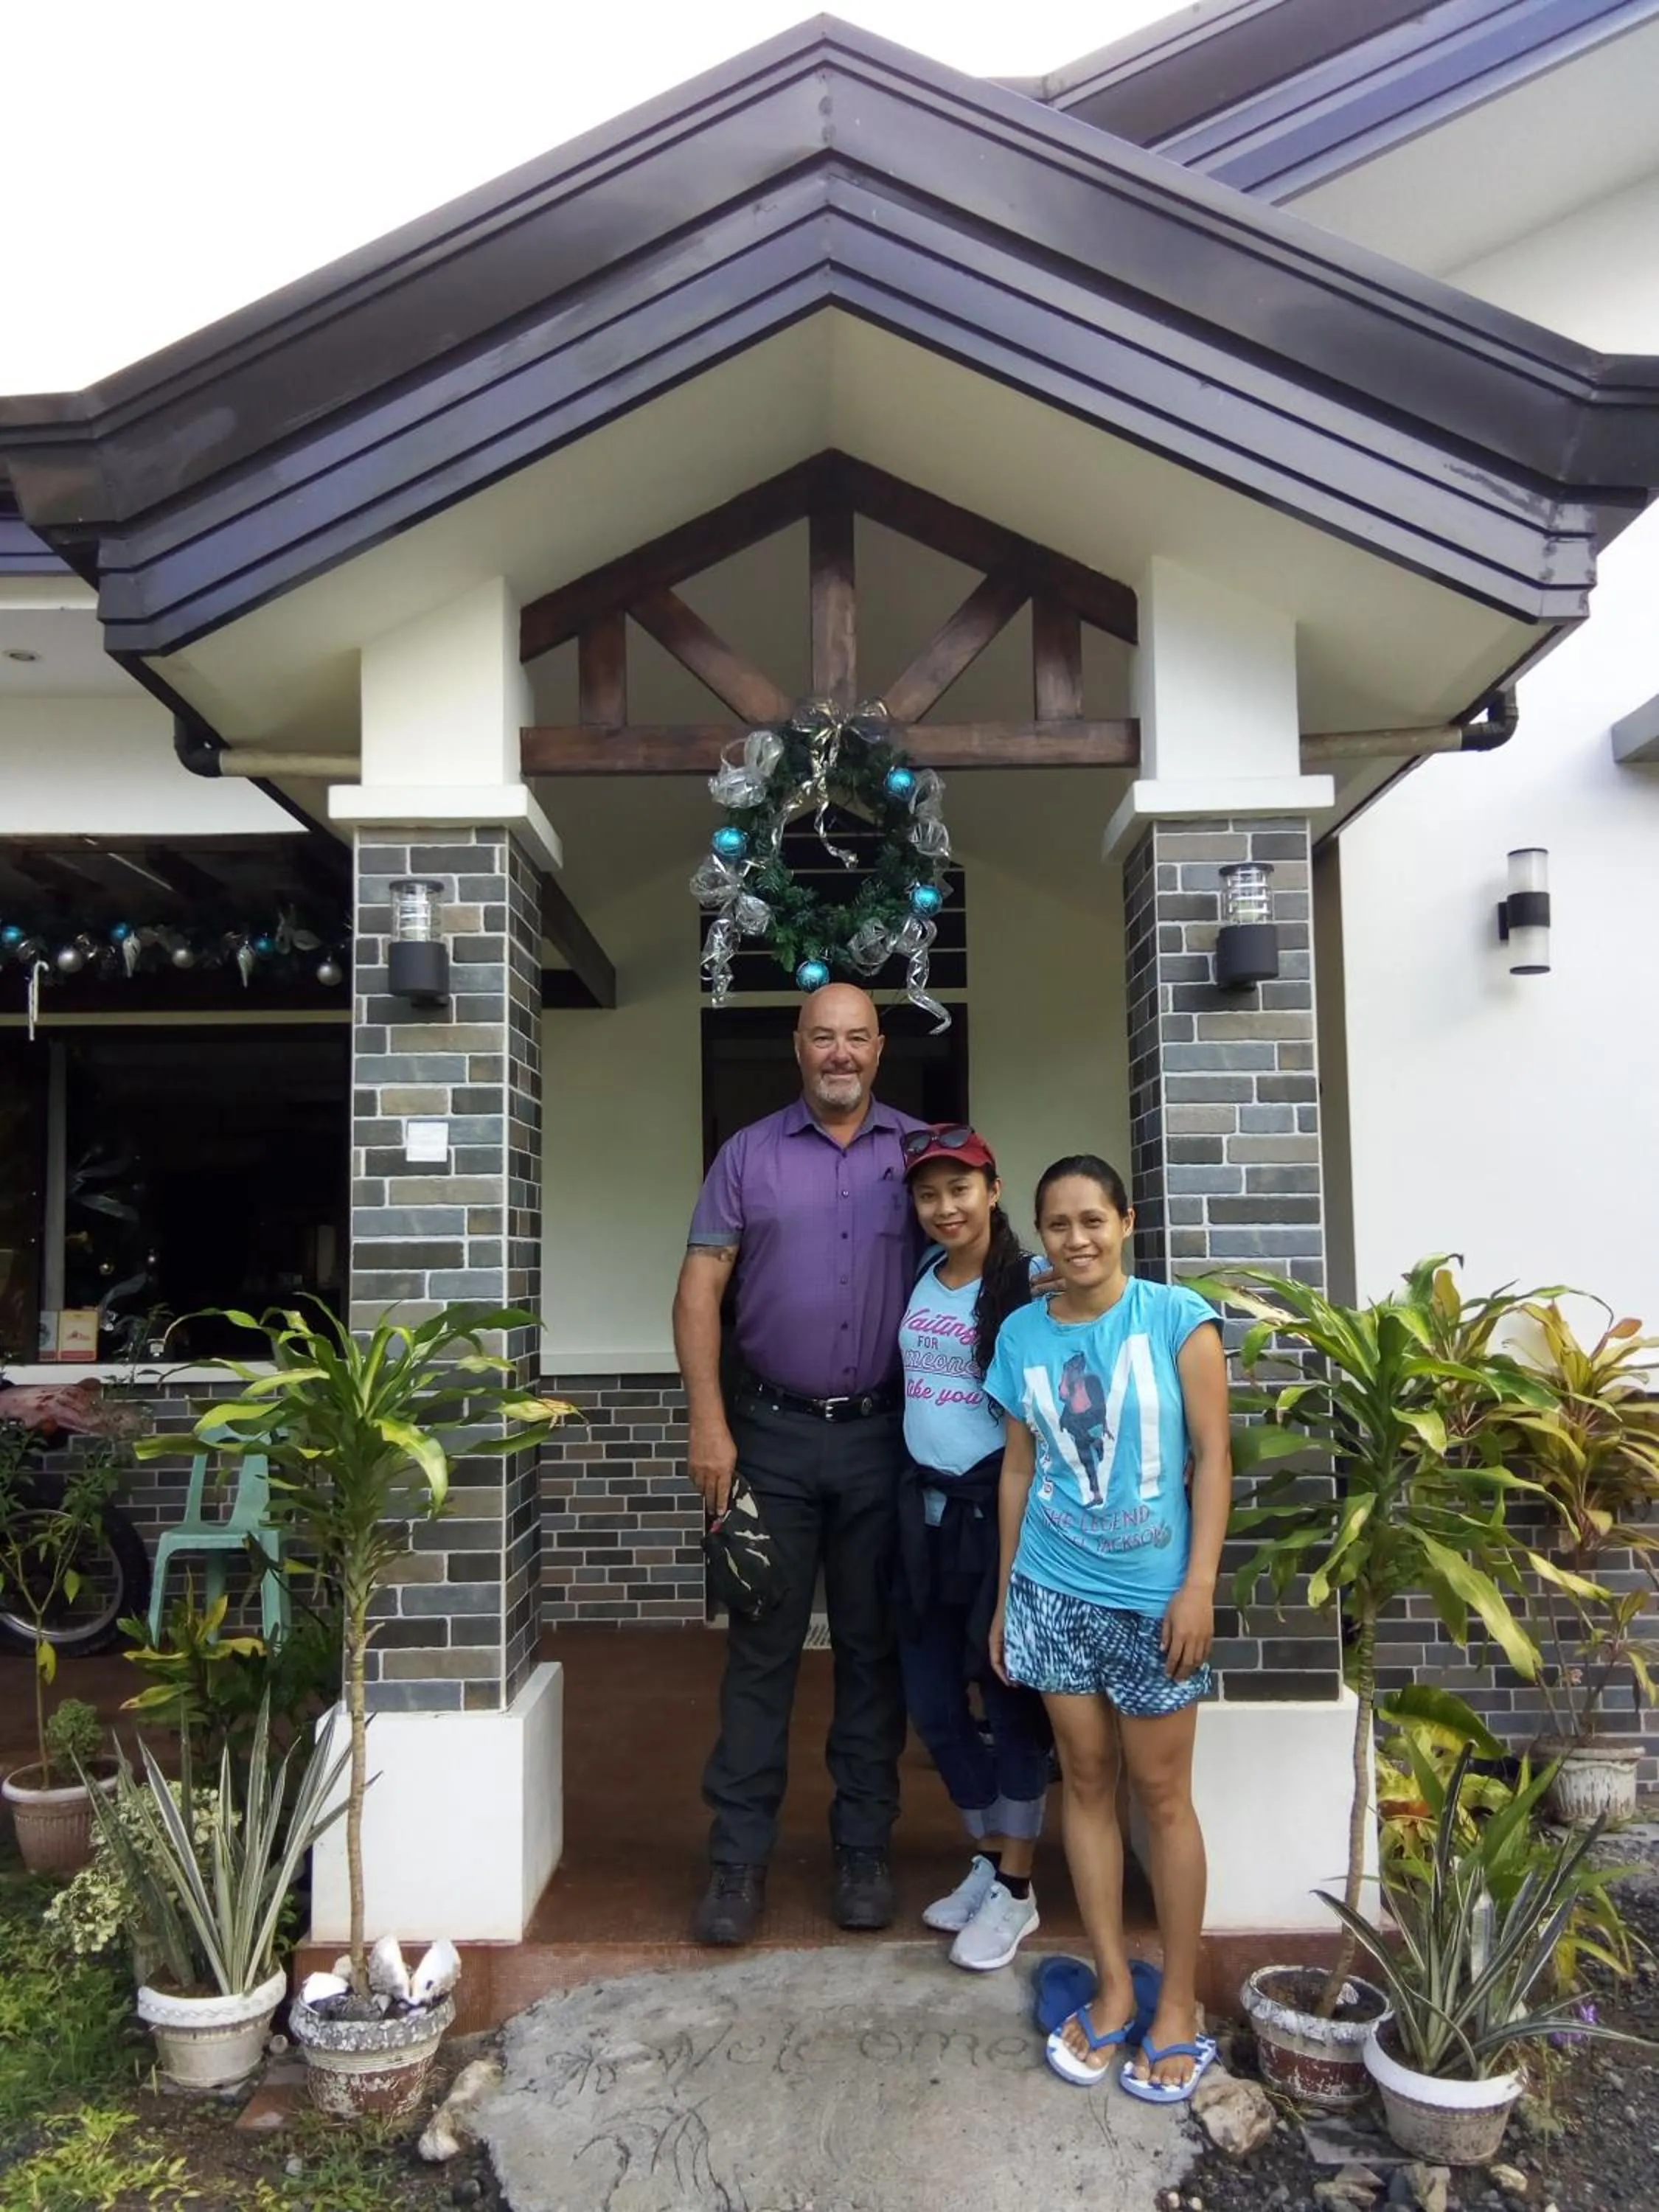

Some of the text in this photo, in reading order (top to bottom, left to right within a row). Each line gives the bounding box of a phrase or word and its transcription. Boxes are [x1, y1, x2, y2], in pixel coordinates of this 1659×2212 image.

[917, 1335, 939, 1349] FOR
[935, 1389, 984, 1405] you
[1081, 1504, 1151, 1532] LEGEND
